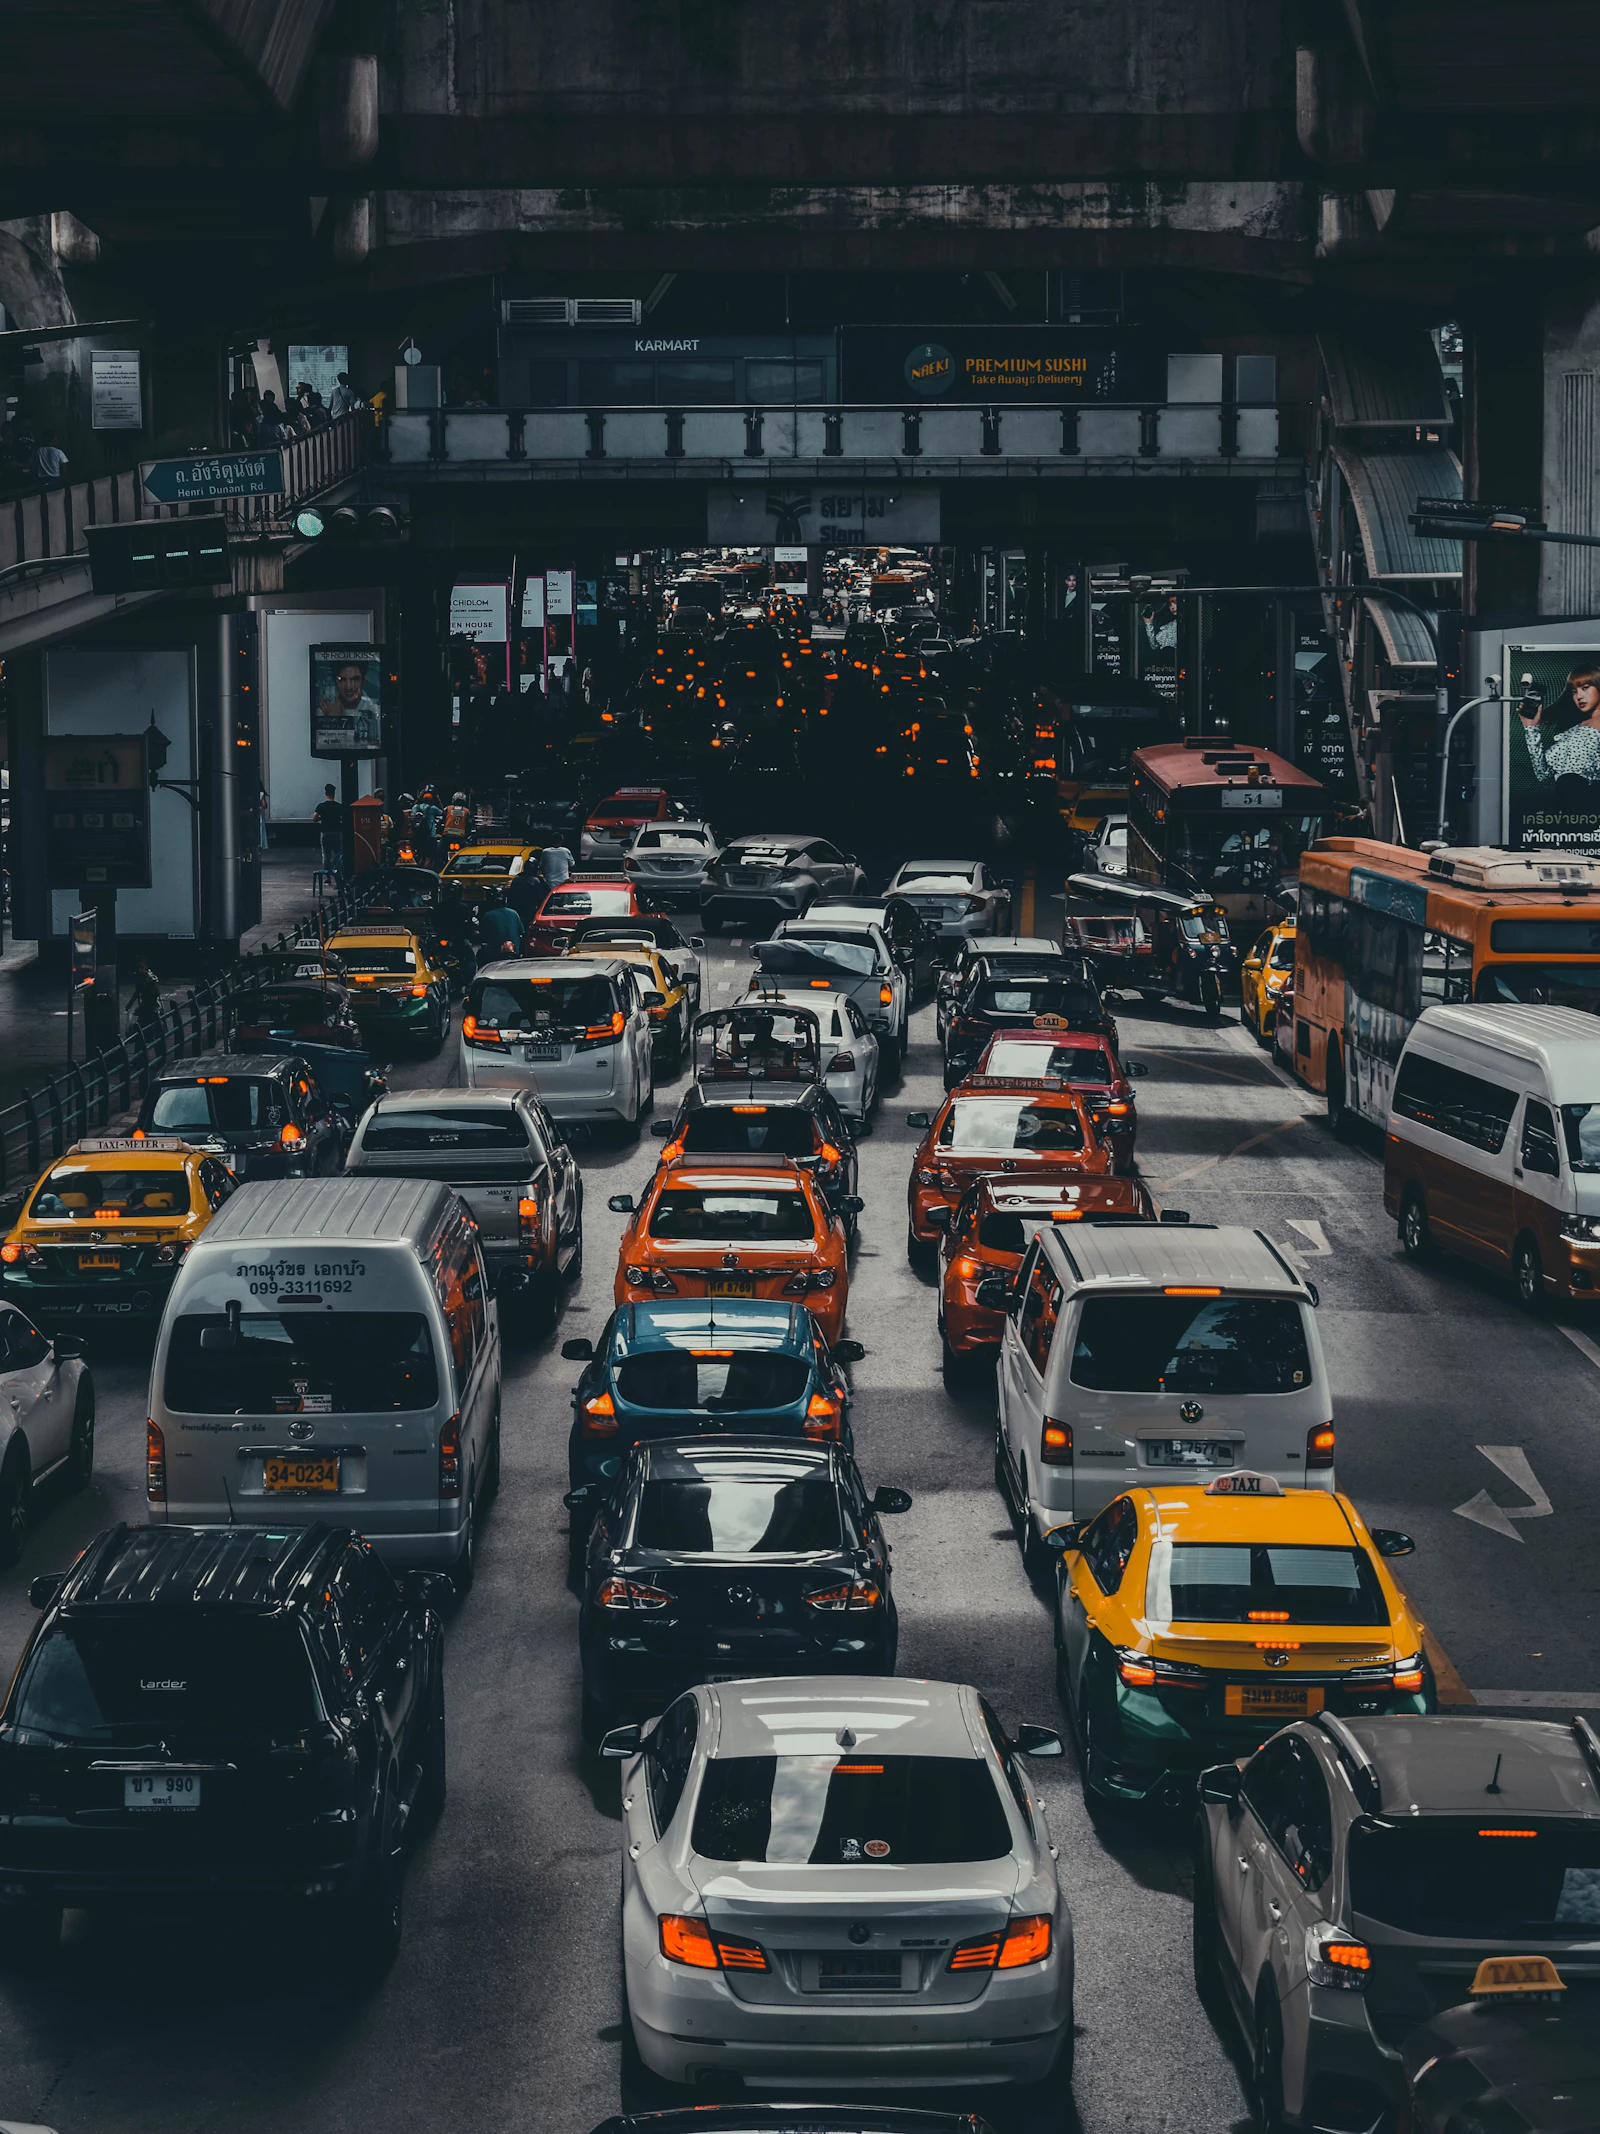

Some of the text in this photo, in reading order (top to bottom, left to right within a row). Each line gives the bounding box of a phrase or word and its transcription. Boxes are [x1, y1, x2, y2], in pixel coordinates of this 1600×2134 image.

[635, 339, 700, 351] KARMART
[911, 357, 949, 381] NAEKI
[965, 358, 1087, 372] PREMIUM SUSHI
[971, 374, 996, 385] Take
[997, 374, 1029, 387] Away
[1038, 374, 1083, 387] Delivery
[175, 457, 267, 484] ถ. อังรีดูนังต์
[177, 481, 267, 498] Henri Dunant Rd.
[820, 495, 885, 518] สยาม
[820, 525, 865, 543] Siam
[1243, 793, 1263, 805] 54
[299, 940, 318, 948] TAXI
[1043, 1018, 1059, 1026] TAXI
[97, 1140, 159, 1149] TAXI-METER
[314, 1259, 366, 1276] เอกบัว
[249, 1280, 353, 1295] 099-3311692
[94, 1303, 132, 1312] TRD
[1150, 1445, 1162, 1458] T
[1187, 1442, 1217, 1455] 7577
[269, 1465, 334, 1483] 34-0234
[1231, 1477, 1261, 1492] TAXI
[166, 1777, 194, 1792] 990
[1487, 1961, 1548, 1985] TAXI
